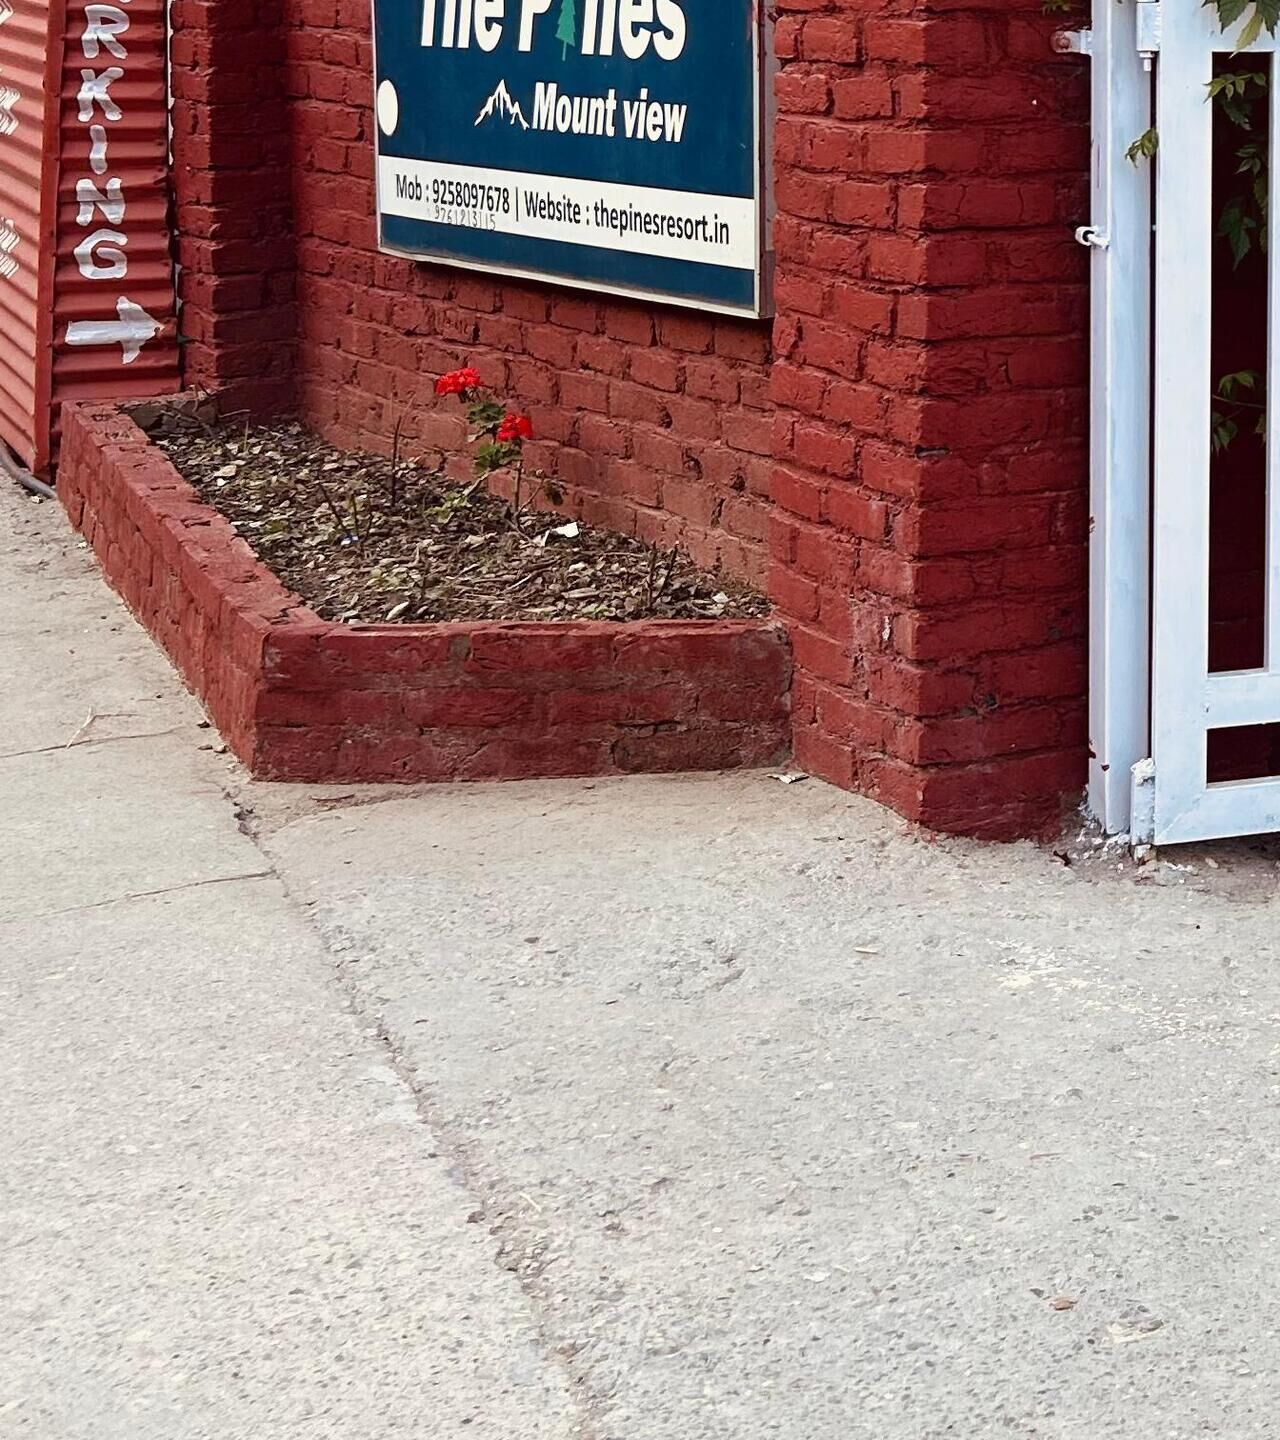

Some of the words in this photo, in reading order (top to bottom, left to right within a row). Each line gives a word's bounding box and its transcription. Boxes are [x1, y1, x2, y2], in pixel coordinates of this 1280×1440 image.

[532, 81, 617, 137] Mount
[623, 87, 687, 143] view
[396, 173, 422, 201] Mob
[432, 178, 510, 214] 9258097678
[524, 190, 581, 224] Website
[593, 197, 731, 245] thepinesresort.in
